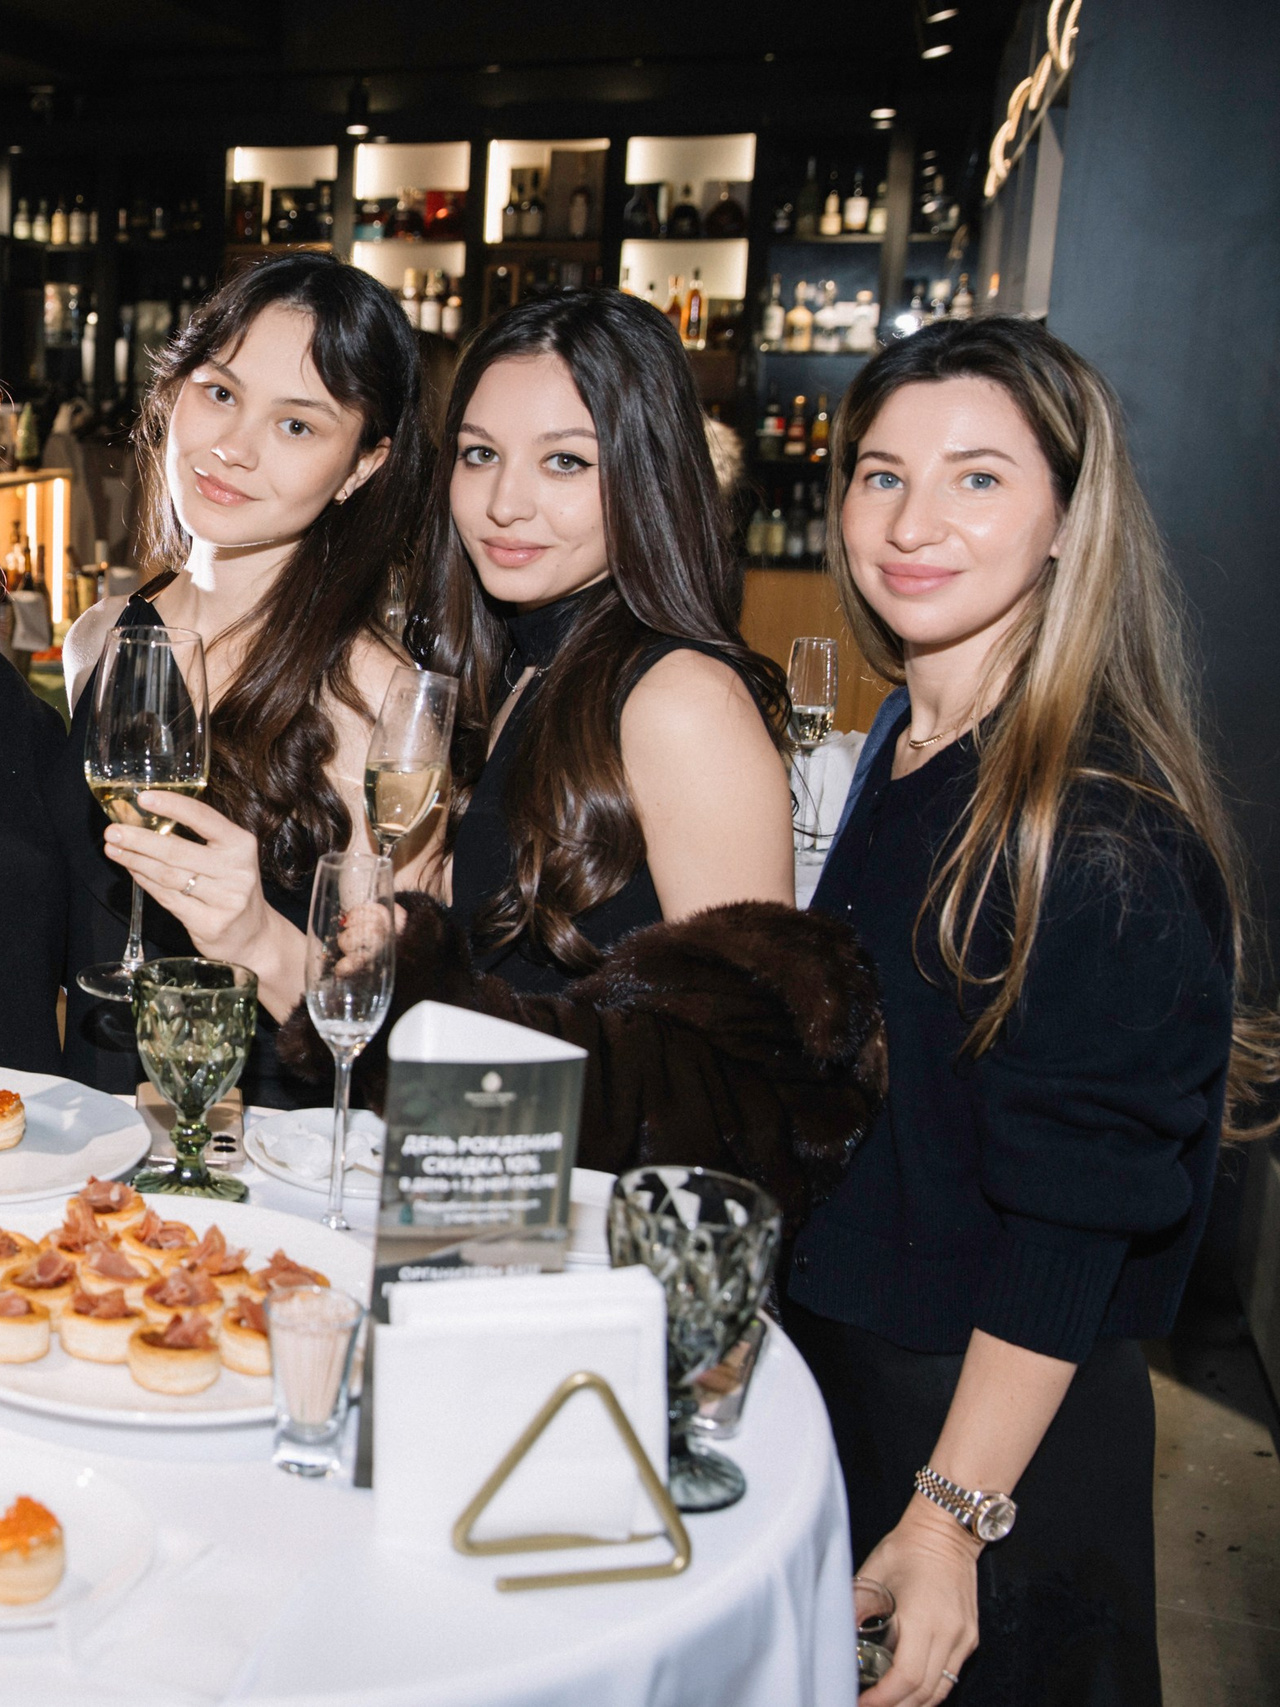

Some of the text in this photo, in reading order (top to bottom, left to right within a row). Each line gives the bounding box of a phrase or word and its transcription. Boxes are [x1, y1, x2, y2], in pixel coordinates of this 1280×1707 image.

[401, 1131, 564, 1157] ДЕНЬ РОЖДЕНИЯ
[422, 1155, 503, 1177] СКИДКА
